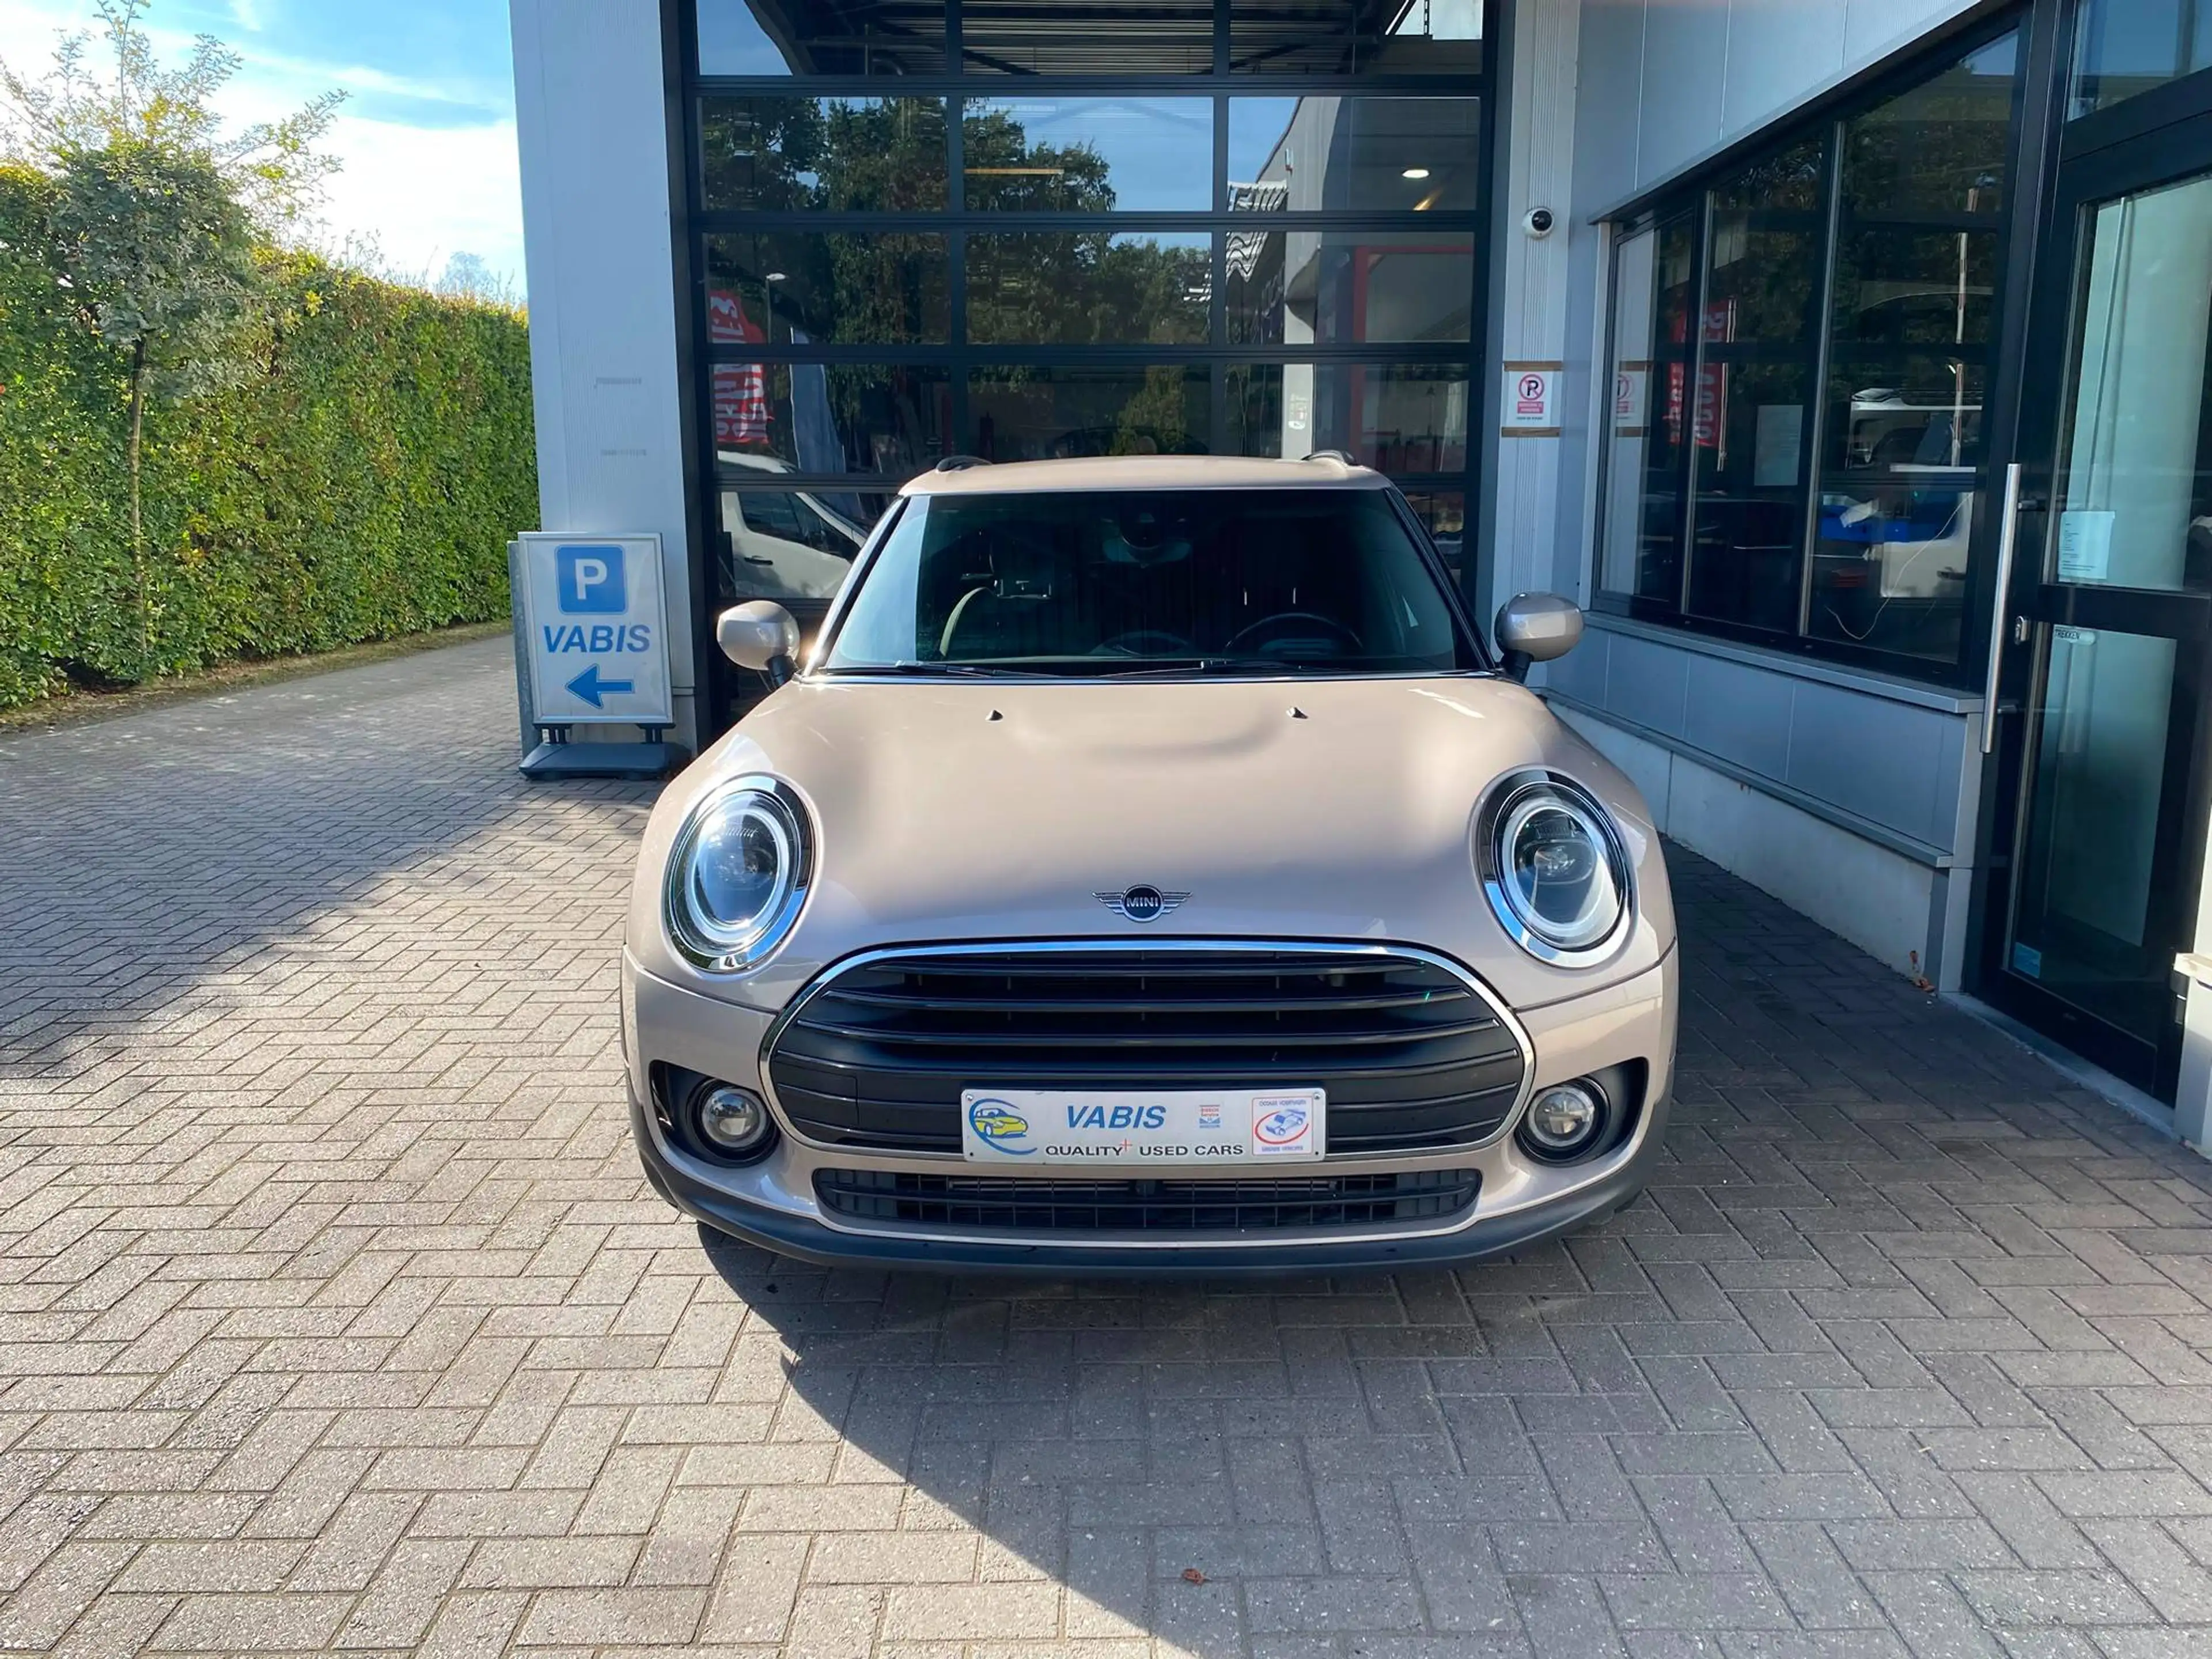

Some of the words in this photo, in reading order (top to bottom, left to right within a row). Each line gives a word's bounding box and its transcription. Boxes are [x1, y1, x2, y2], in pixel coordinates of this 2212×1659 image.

[574, 558, 608, 600] P
[543, 624, 651, 653] VABIS
[1126, 896, 1159, 907] MINI
[1067, 1105, 1166, 1129] VABIS
[1045, 1145, 1123, 1156] QUALITY
[1139, 1146, 1188, 1156] USED
[1194, 1145, 1244, 1156] CARS
